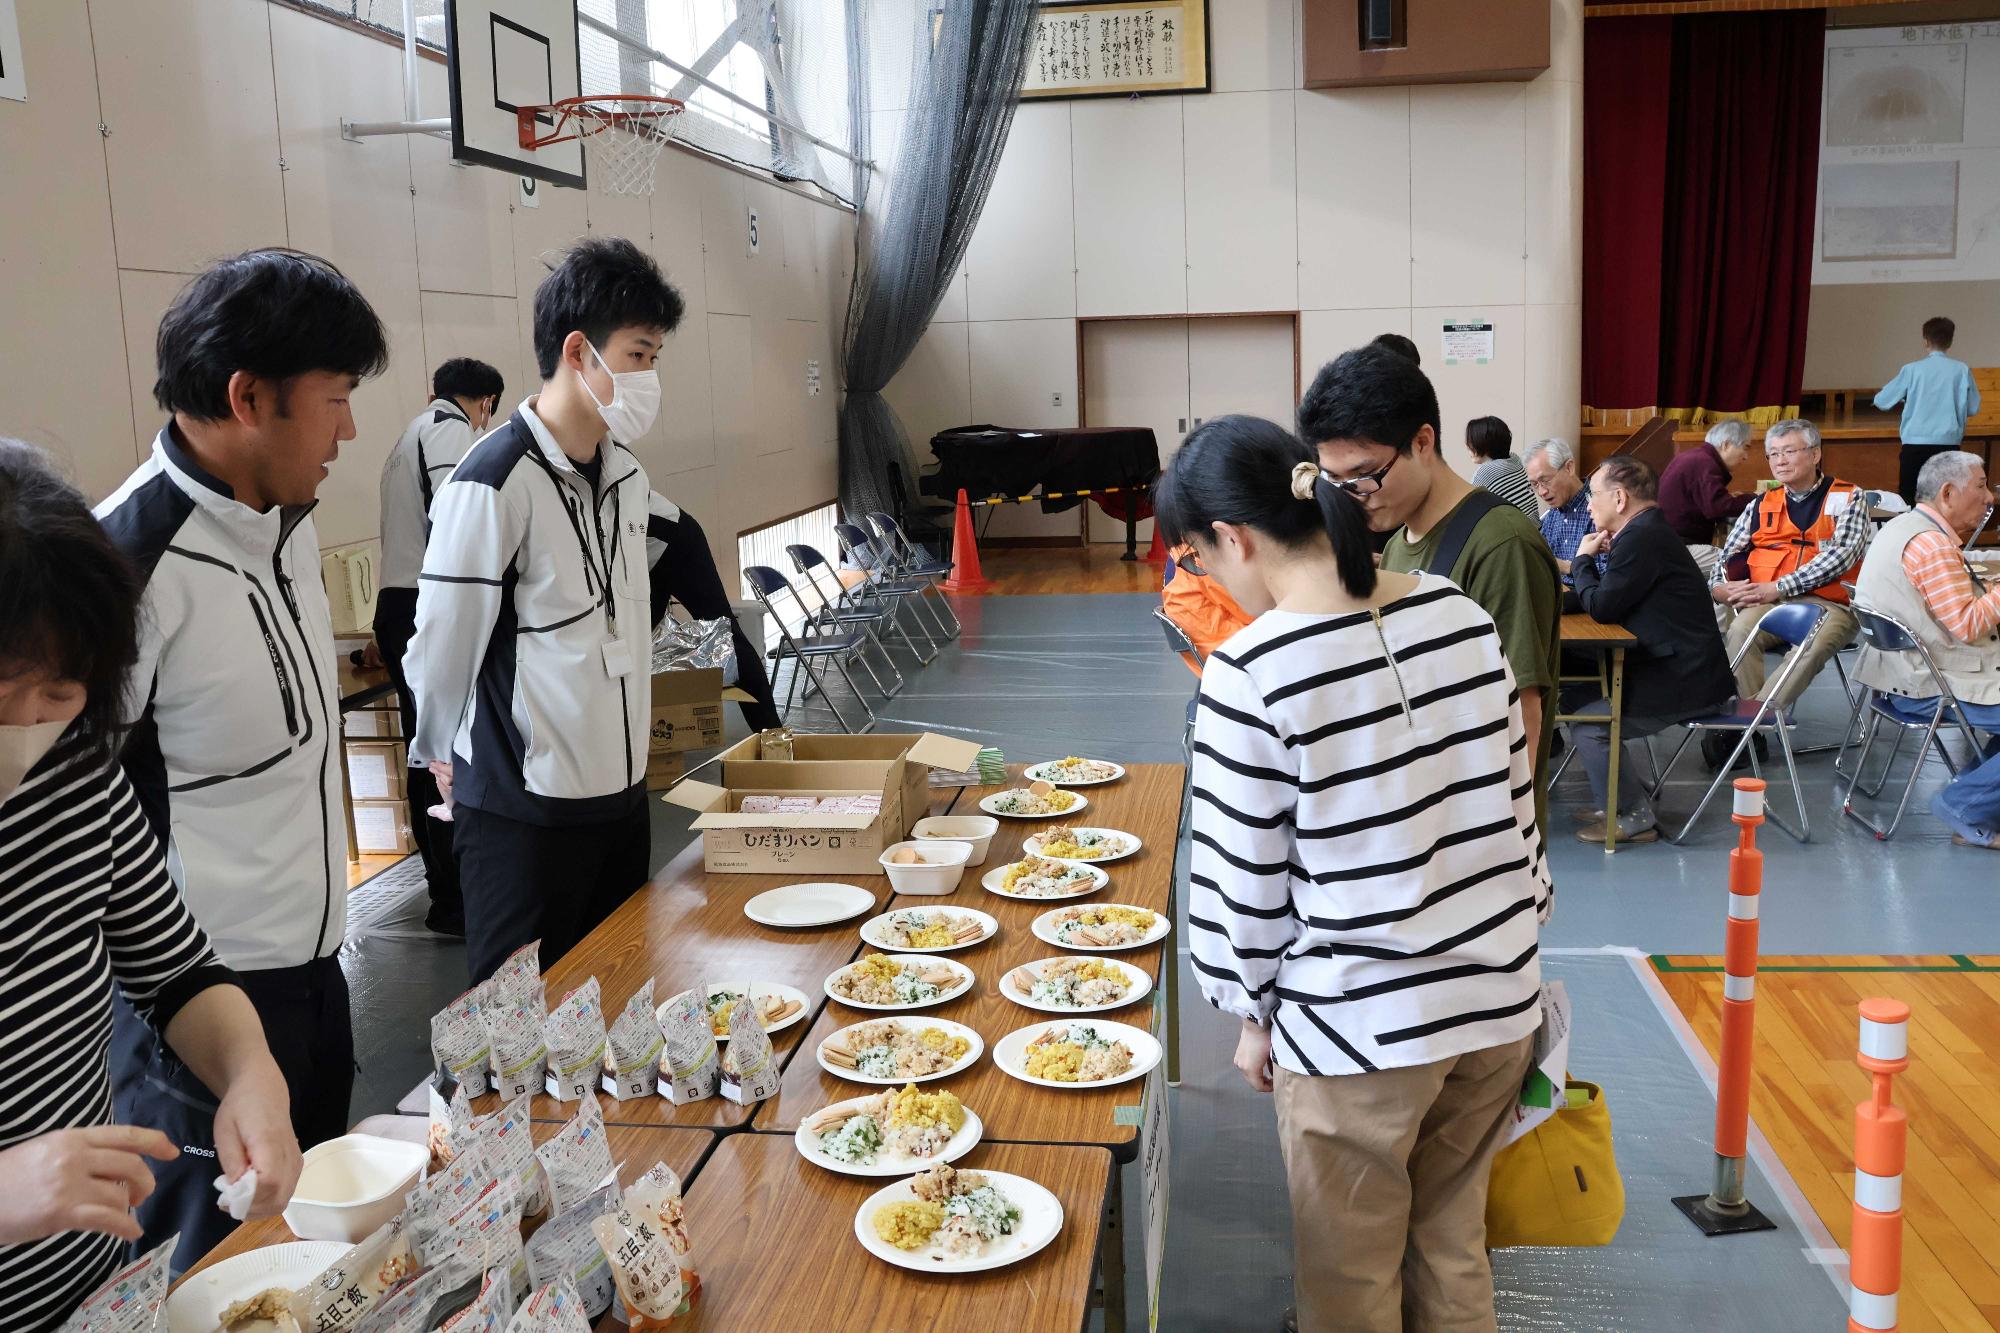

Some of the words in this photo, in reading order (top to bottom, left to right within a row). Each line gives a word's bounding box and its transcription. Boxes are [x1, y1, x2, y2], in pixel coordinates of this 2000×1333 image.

[750, 214, 758, 247] 5
[744, 832, 821, 848] ひだまりパン
[183, 1145, 215, 1158] CROSS
[315, 1282, 369, 1333] 五目ご飯
